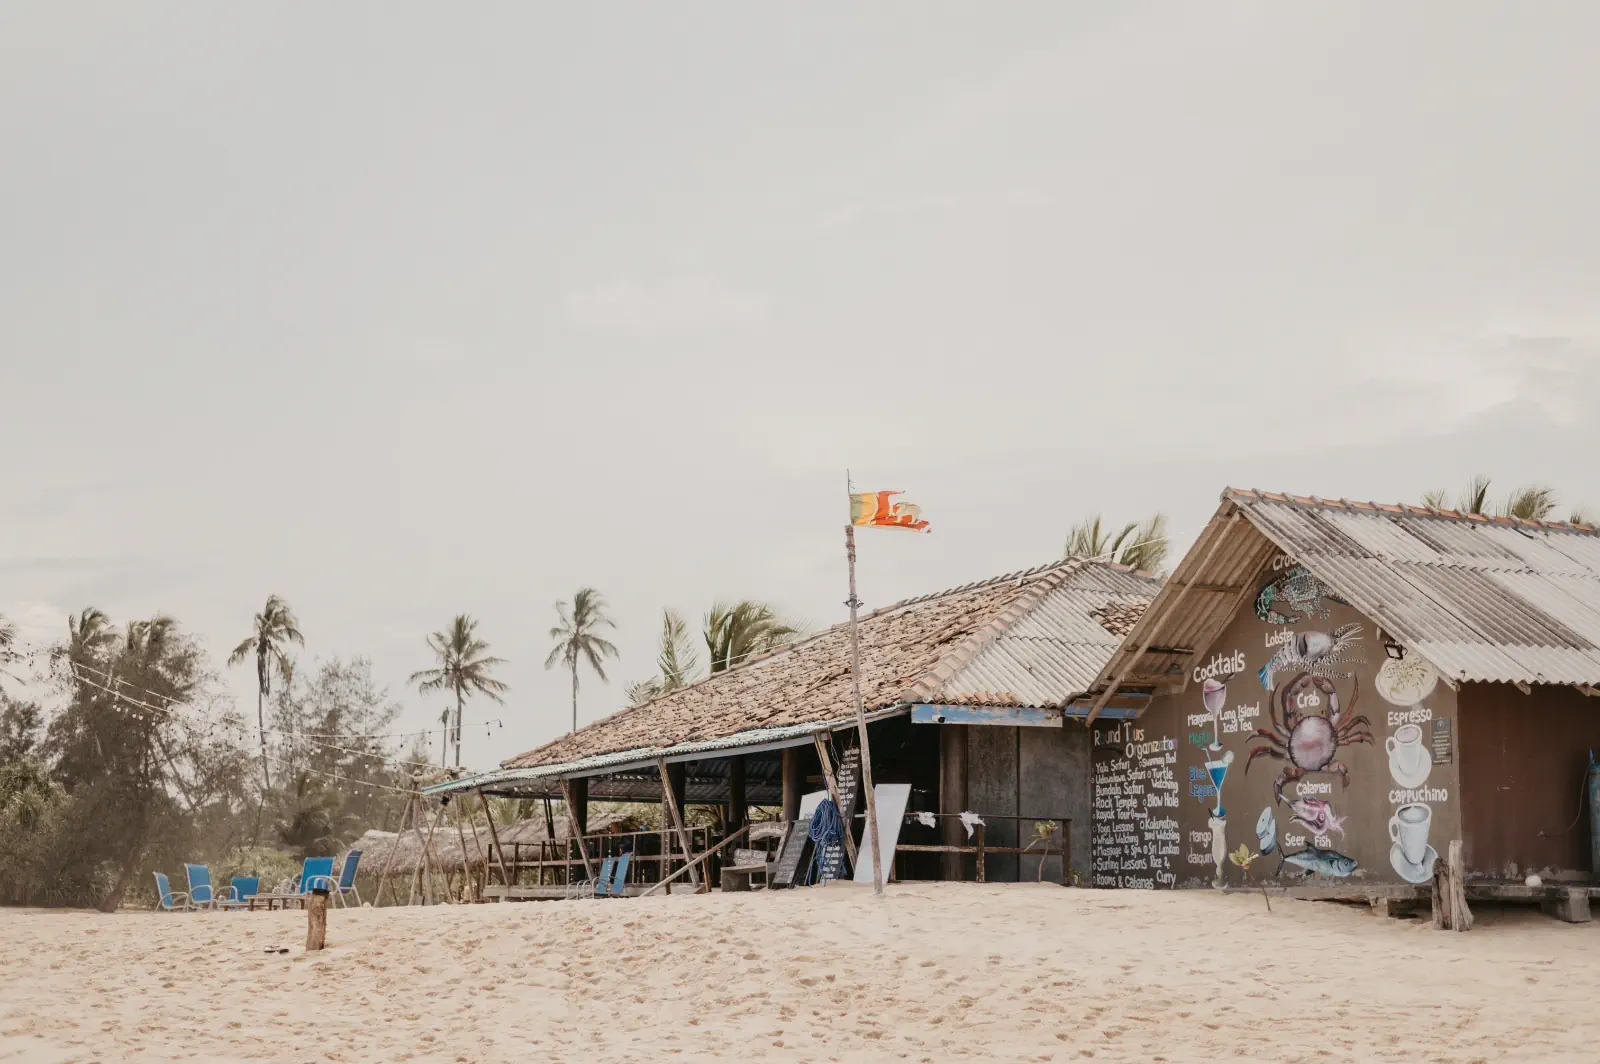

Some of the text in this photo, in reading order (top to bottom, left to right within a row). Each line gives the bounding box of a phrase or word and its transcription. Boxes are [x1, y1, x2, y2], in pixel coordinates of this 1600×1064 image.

[1265, 626, 1294, 648] Lobster
[1193, 649, 1245, 683] Cocktails
[1297, 690, 1320, 708] Crab
[1220, 701, 1259, 724] Long Island
[1387, 709, 1432, 726] Espresso
[1223, 718, 1253, 733] Iced Tea
[1165, 751, 1176, 763] Pool
[1096, 758, 1130, 773] Yala Safari
[1152, 766, 1173, 780] Turtle
[1127, 767, 1146, 780] Safari
[1188, 766, 1206, 781] Blue
[1096, 780, 1144, 797] Bundala Safari
[1151, 779, 1178, 793] Watching
[1296, 780, 1331, 796] Calamari
[1096, 795, 1137, 811] Rock Temple
[1147, 792, 1179, 808] Blow Hole
[1097, 821, 1134, 836] Yoga Lessons
[1097, 832, 1139, 846] Whale Watching
[1285, 832, 1331, 848] Seer Fish
[1097, 844, 1142, 858] Massage & Spa
[1148, 840, 1180, 855] Sri Lankan
[1097, 855, 1147, 873] Surfing Lessons
[1150, 855, 1162, 868] Rice
[1097, 874, 1116, 886] Rooms
[1124, 875, 1154, 889] Cabanas
[1156, 869, 1177, 889] Curry
